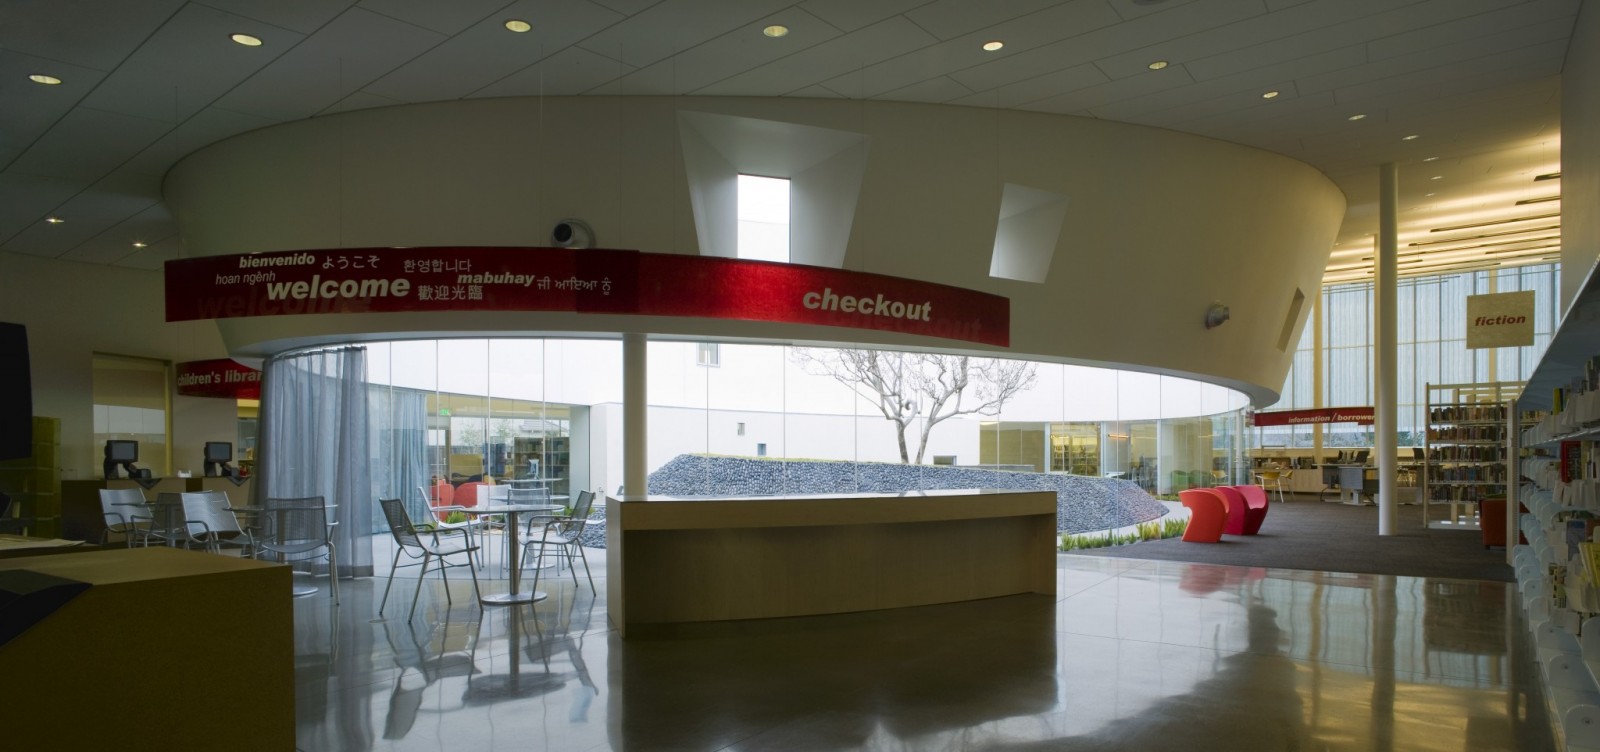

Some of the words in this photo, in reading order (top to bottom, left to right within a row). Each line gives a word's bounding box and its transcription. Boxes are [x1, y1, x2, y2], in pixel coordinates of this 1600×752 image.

[239, 252, 316, 268] bienvenido
[321, 254, 381, 270] ようこそ
[402, 257, 473, 274] 환영합니다
[215, 272, 241, 286] hoan
[266, 274, 411, 301] welcome
[457, 271, 535, 288] mabuhay
[417, 284, 484, 301] 歡迎光臨
[802, 287, 932, 322] checkout
[1474, 315, 1526, 327] fiction
[177, 370, 222, 387] children's
[224, 369, 263, 383] librar
[1288, 415, 1331, 424] information
